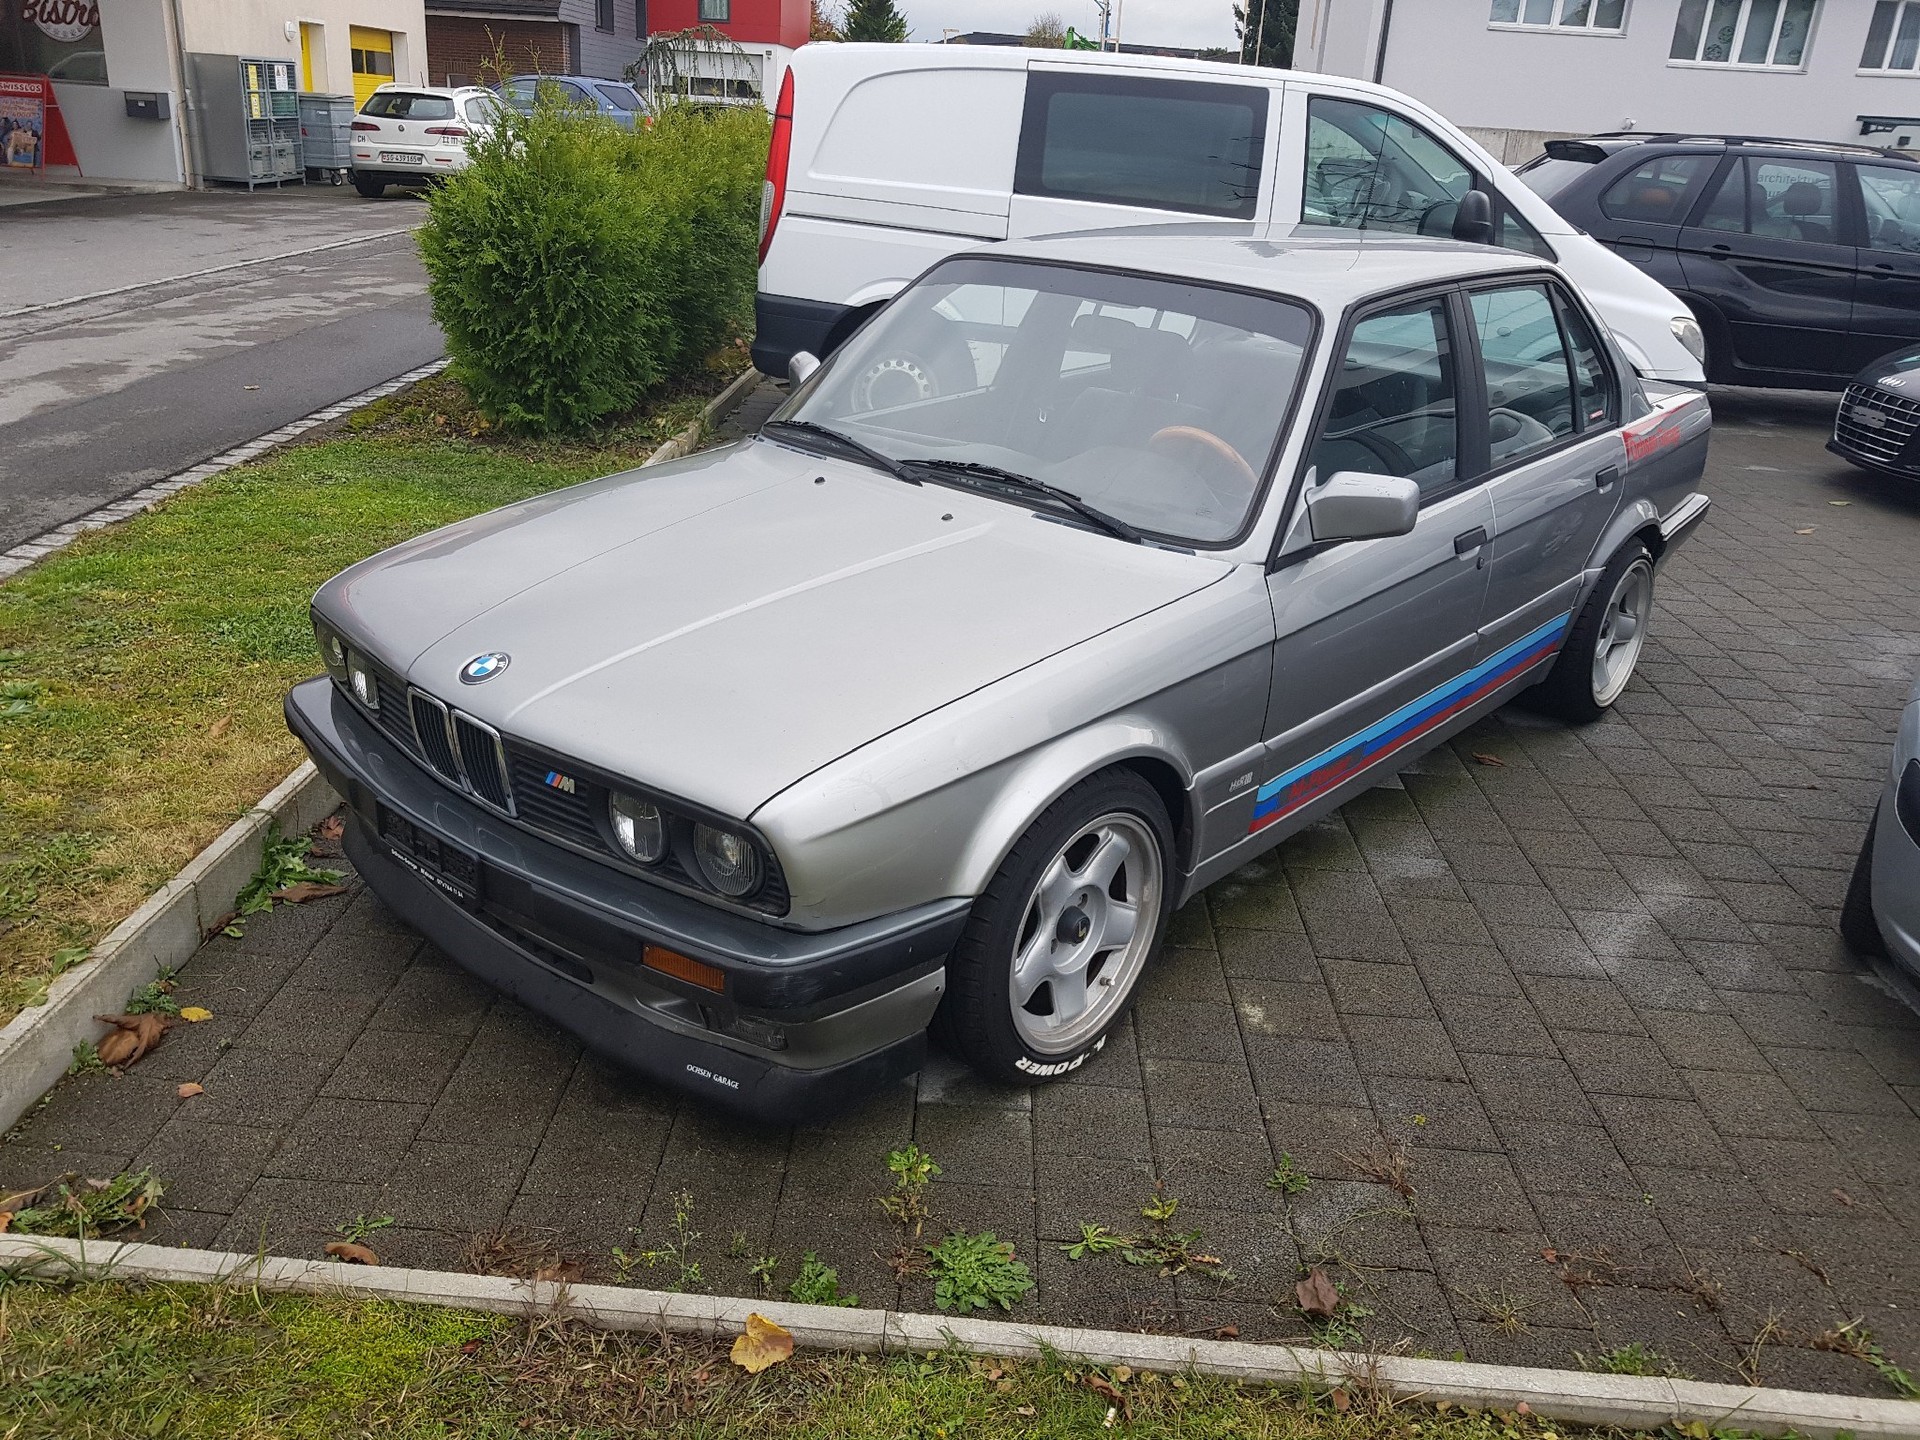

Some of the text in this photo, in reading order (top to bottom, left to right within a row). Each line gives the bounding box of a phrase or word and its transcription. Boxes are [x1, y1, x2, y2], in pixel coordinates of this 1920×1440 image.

[22, 0, 99, 26] Bistro
[0, 82, 41, 92] SWISSLOS
[357, 135, 366, 143] CH
[558, 776, 575, 795] M
[686, 1064, 740, 1090] OCHSEN GARAGE
